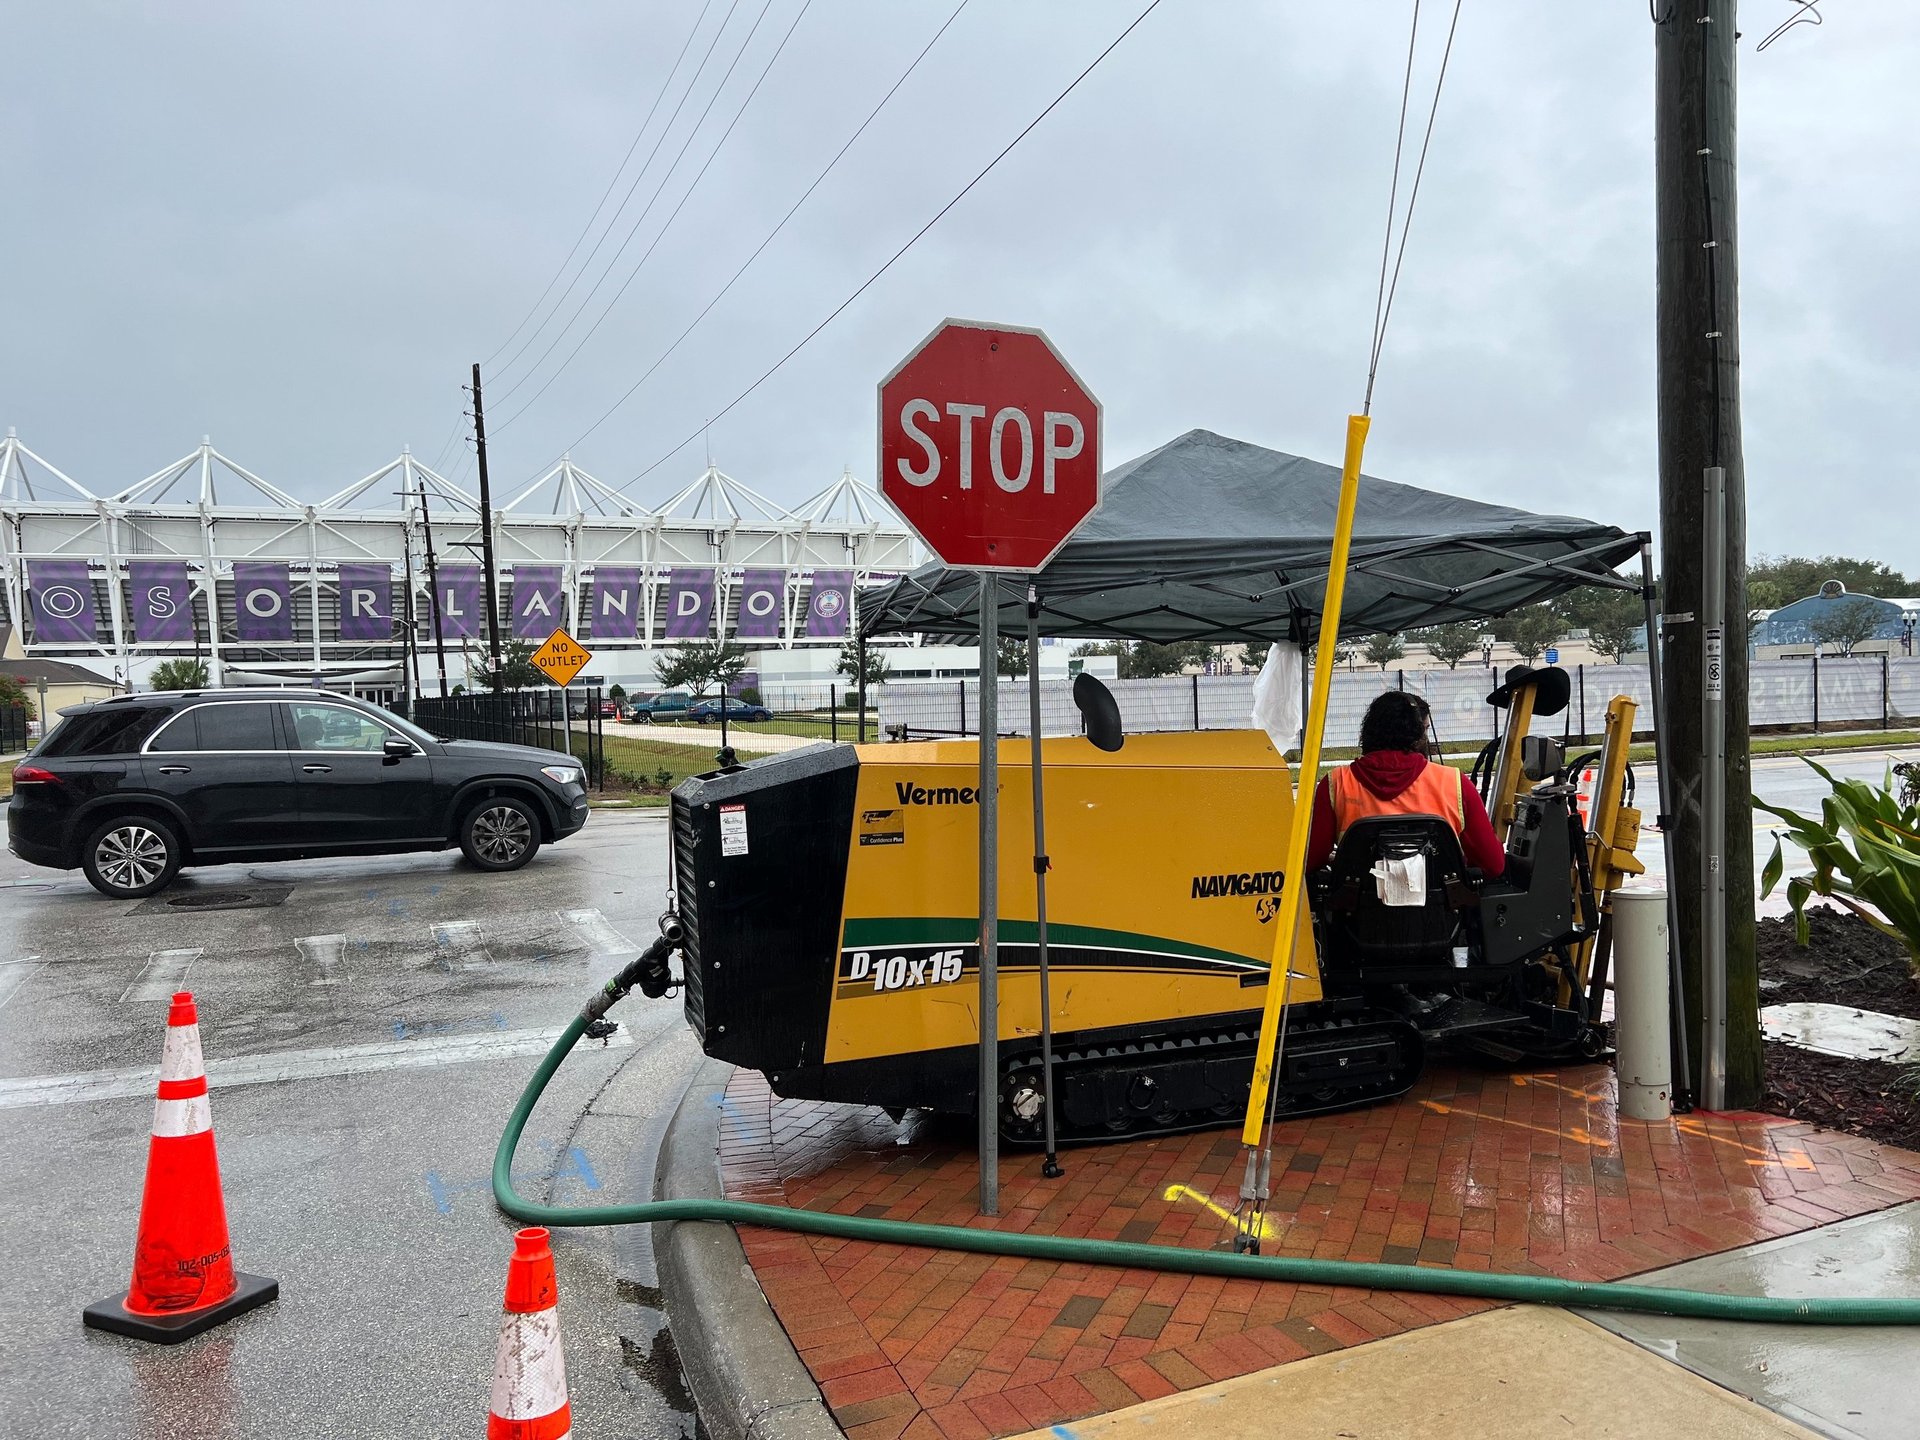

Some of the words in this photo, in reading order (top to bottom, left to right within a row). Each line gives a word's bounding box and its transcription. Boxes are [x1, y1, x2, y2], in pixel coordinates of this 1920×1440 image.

[897, 398, 1085, 495] STOP
[552, 642, 569, 653] NO
[540, 655, 584, 667] OUTLET
[895, 782, 999, 806] Verme
[1191, 871, 1285, 898] NAVIGATO
